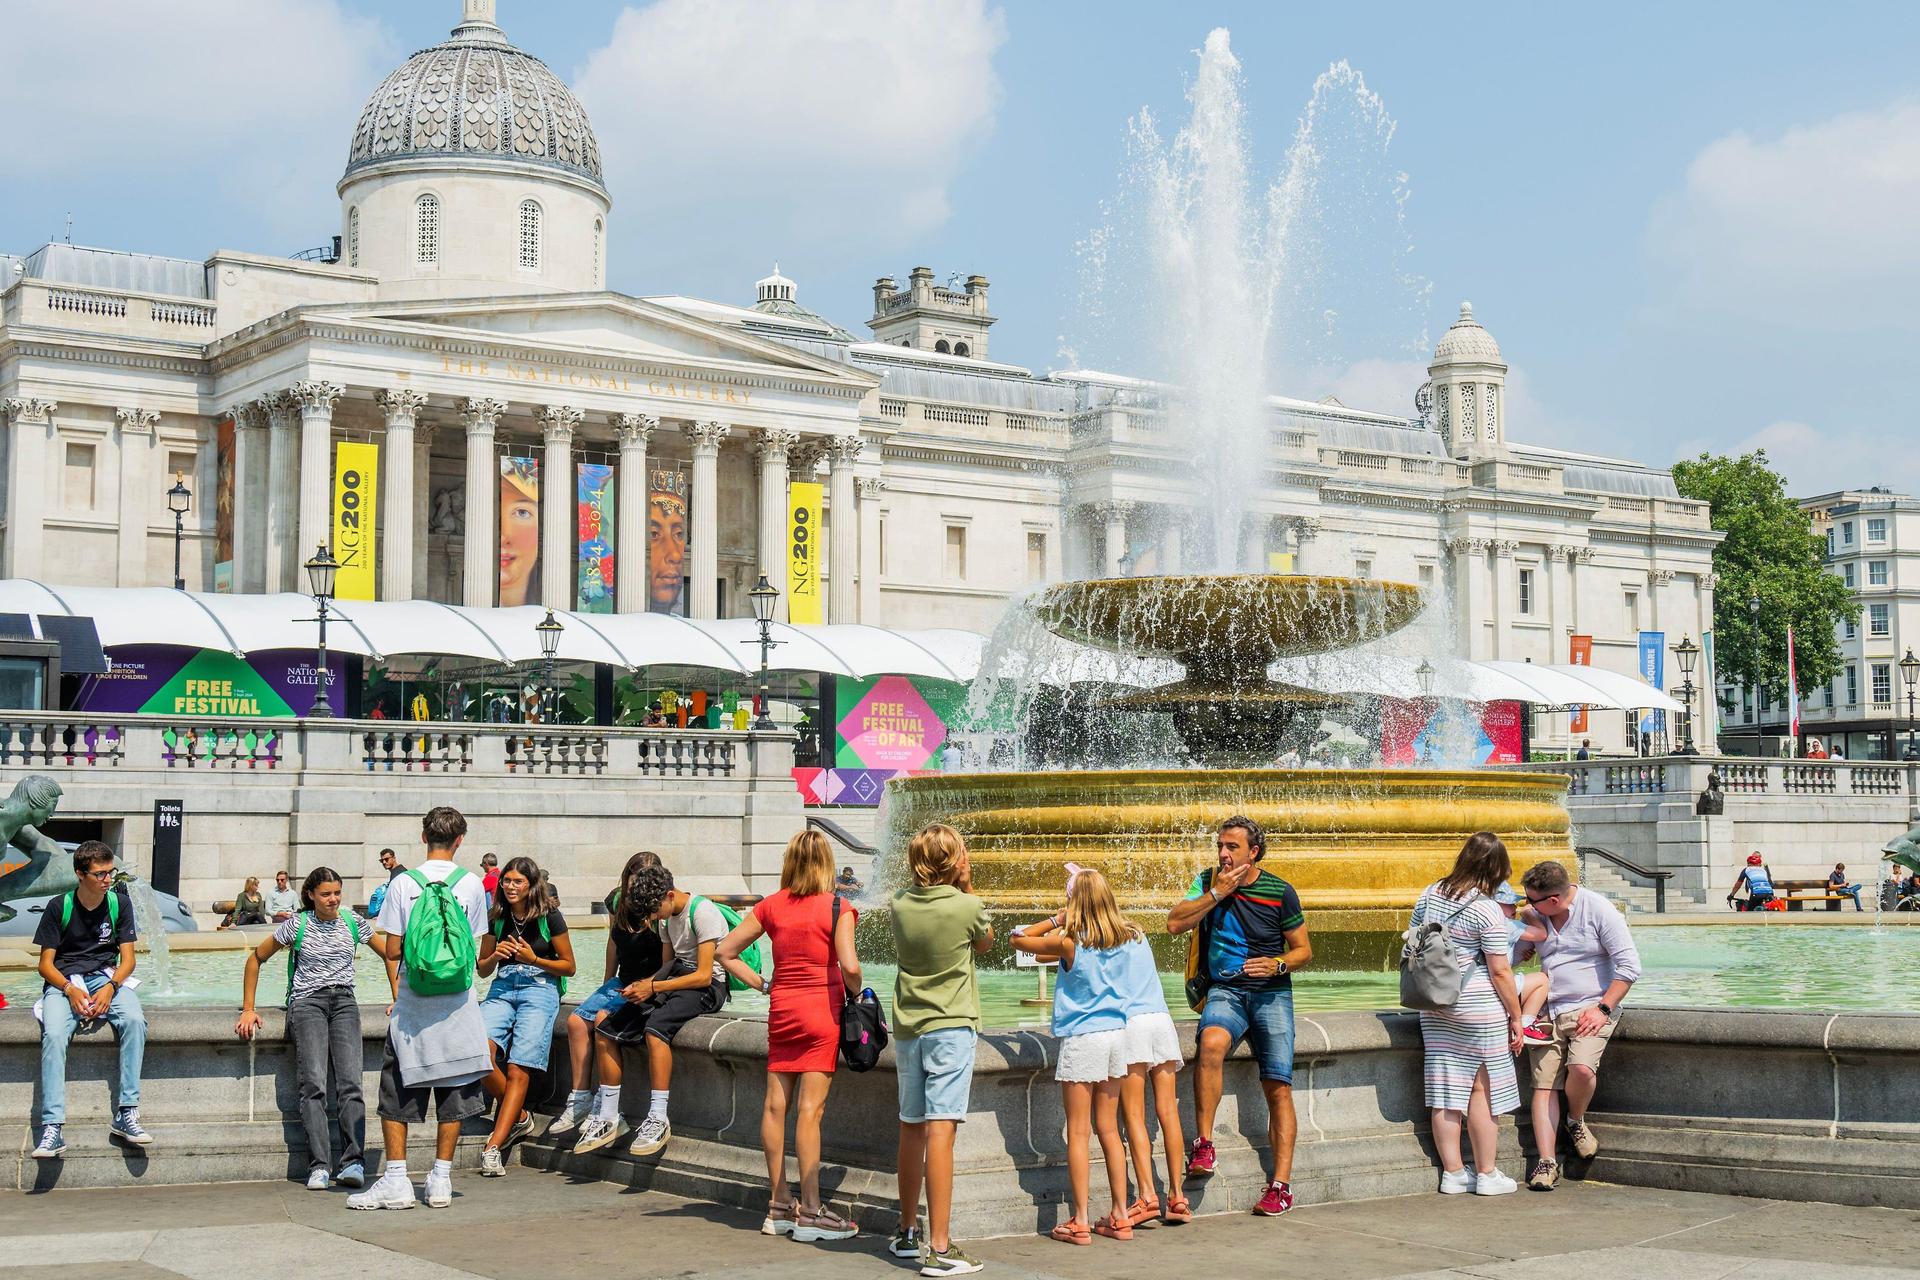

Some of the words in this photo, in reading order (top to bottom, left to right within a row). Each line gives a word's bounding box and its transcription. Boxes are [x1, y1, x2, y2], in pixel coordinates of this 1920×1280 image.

[442, 355, 489, 376] THE
[507, 362, 631, 392] NATIONAL
[648, 380, 752, 403] GALLERY
[341, 470, 361, 568] NG200
[793, 507, 809, 596] NG200
[287, 667, 336, 677] NATIOAL
[186, 680, 233, 697] FREE
[175, 697, 261, 715] FESTIVAL
[871, 702, 905, 717] FREE
[862, 716, 925, 731] FESTIVAL
[878, 733, 896, 747] OF
[898, 733, 925, 748] ART
